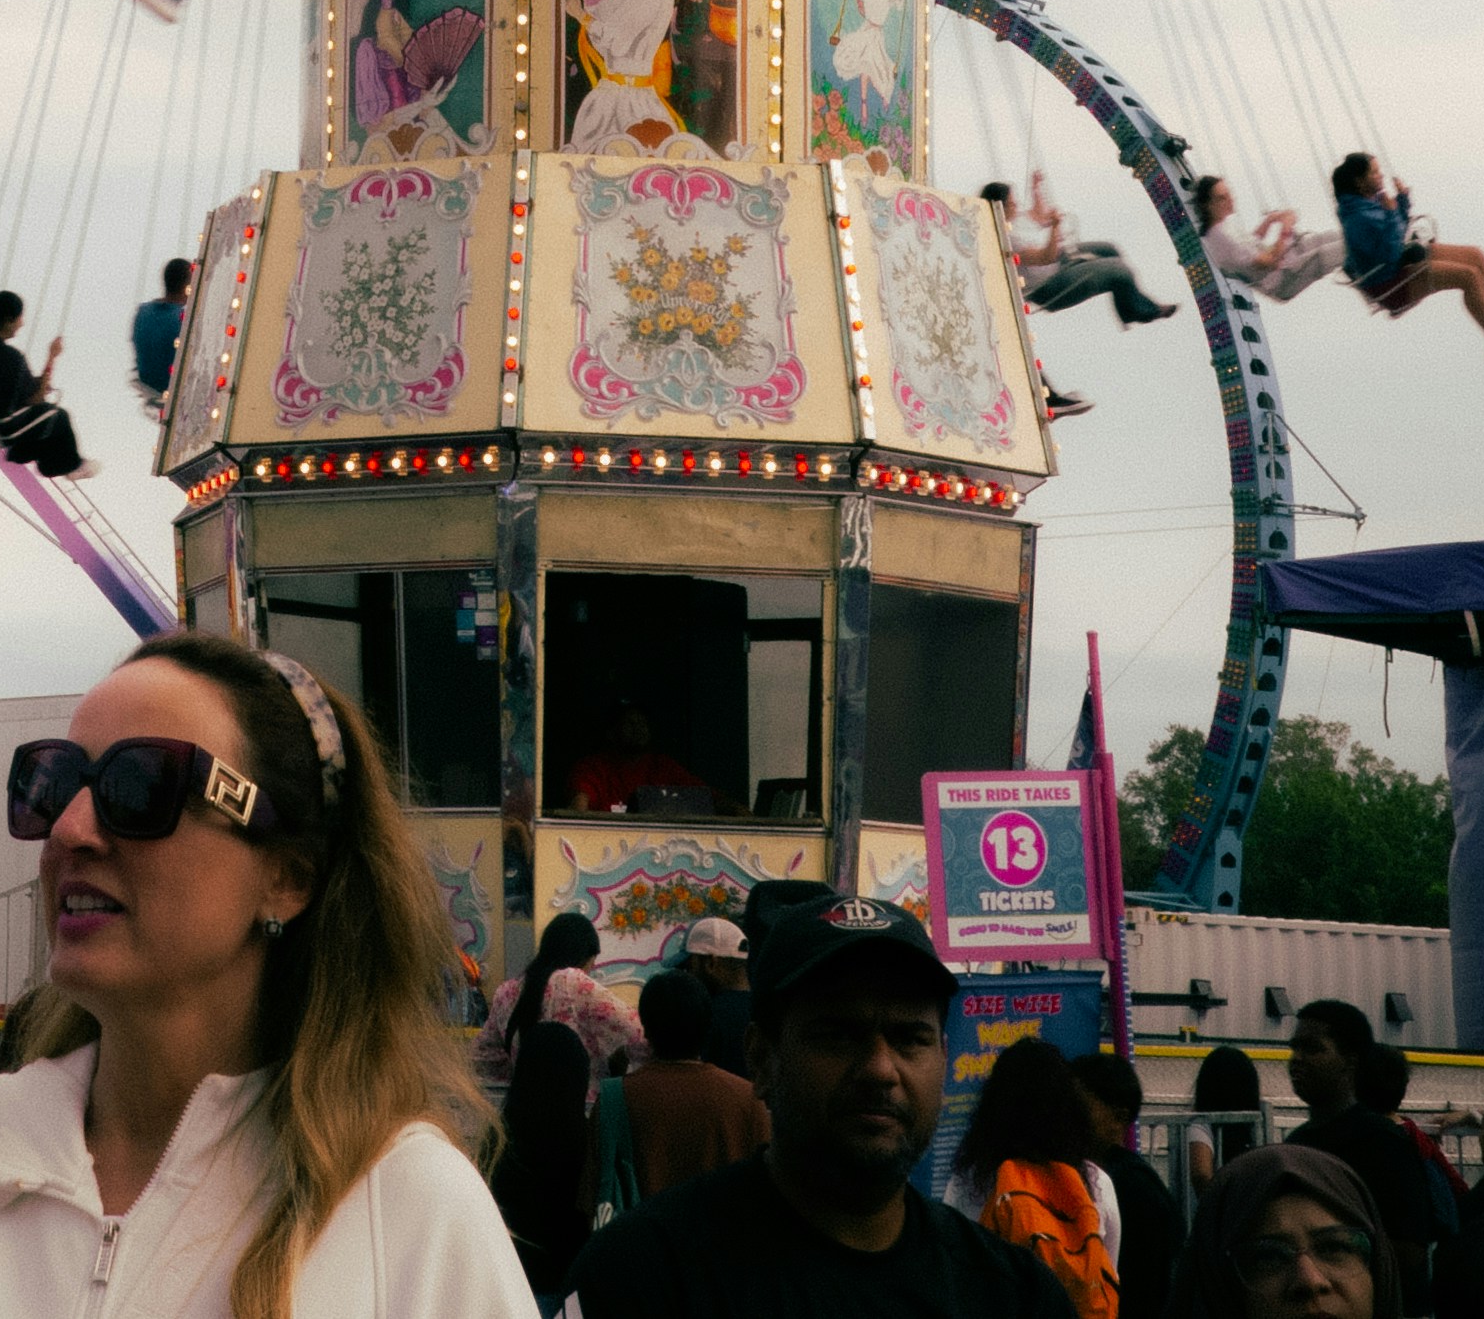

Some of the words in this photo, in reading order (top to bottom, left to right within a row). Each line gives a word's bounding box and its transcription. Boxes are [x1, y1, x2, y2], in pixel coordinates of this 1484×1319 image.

[947, 789, 981, 802] THIS
[986, 788, 1020, 802] RIDE
[1024, 787, 1071, 801] TAKES
[986, 825, 1039, 871] 13
[978, 890, 1056, 912] TICKETS
[963, 994, 1006, 1017] SIZE
[1013, 992, 1062, 1016] WIZE
